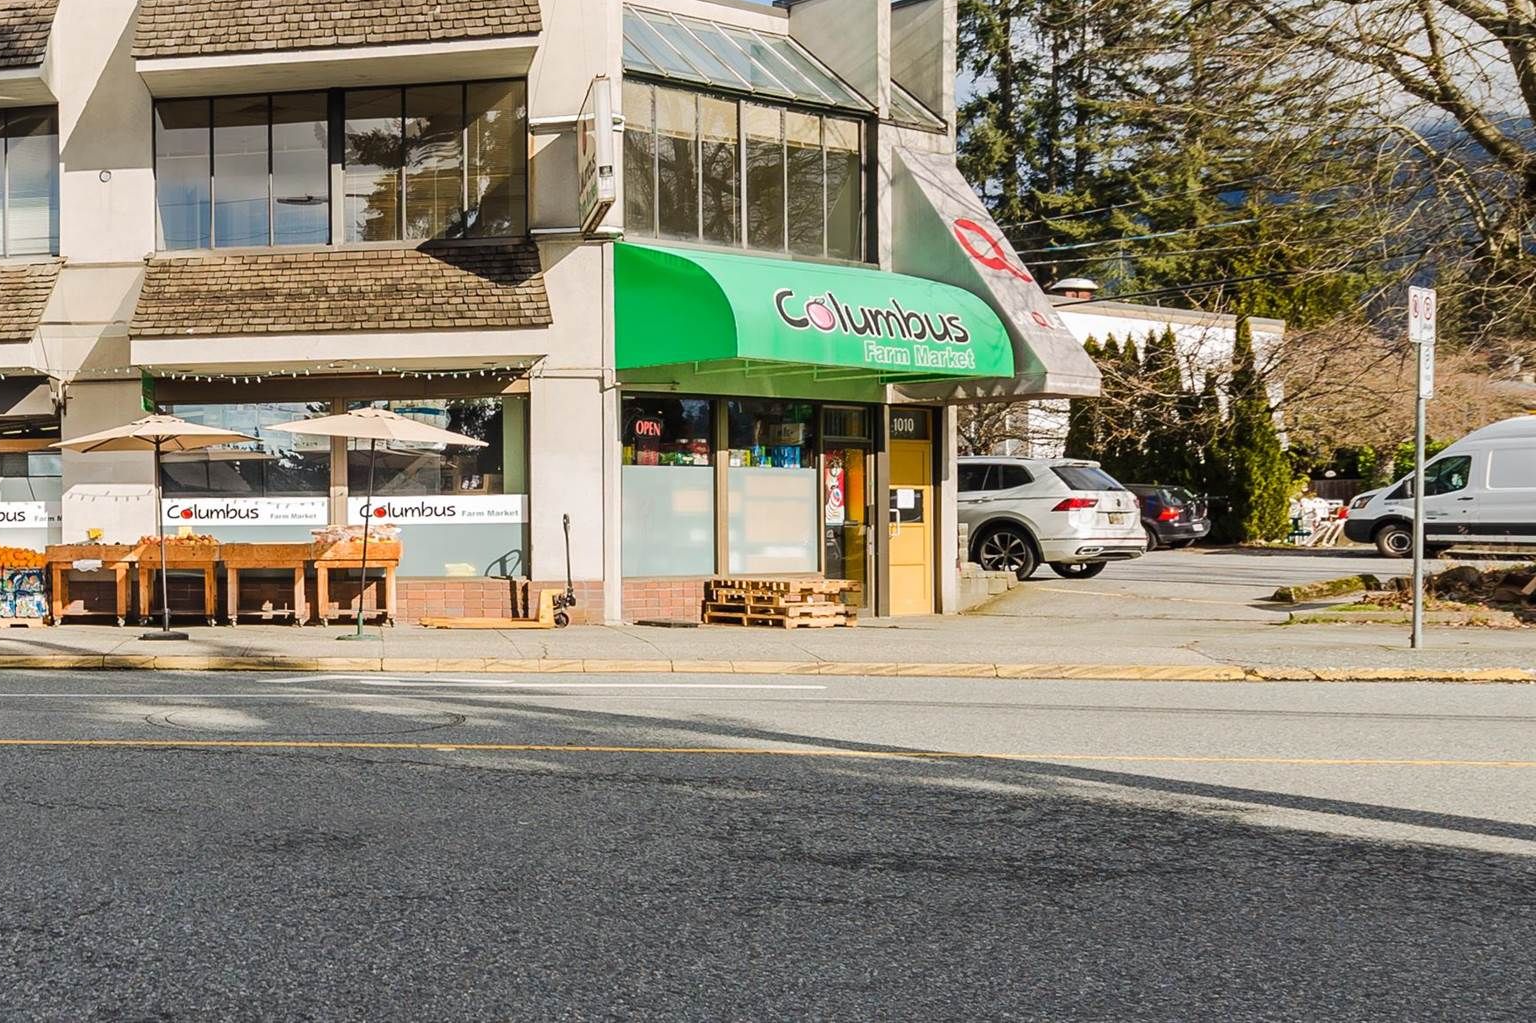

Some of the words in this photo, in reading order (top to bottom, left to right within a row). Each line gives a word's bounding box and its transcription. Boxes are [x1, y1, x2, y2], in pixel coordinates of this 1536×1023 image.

[774, 289, 970, 344] Columbus
[865, 341, 910, 364] Farm
[914, 344, 975, 369] Market
[635, 420, 661, 436] OPEN
[893, 417, 914, 432] 1010
[166, 504, 259, 519] Columbus
[360, 501, 456, 518] Columbus
[487, 509, 519, 517] Market
